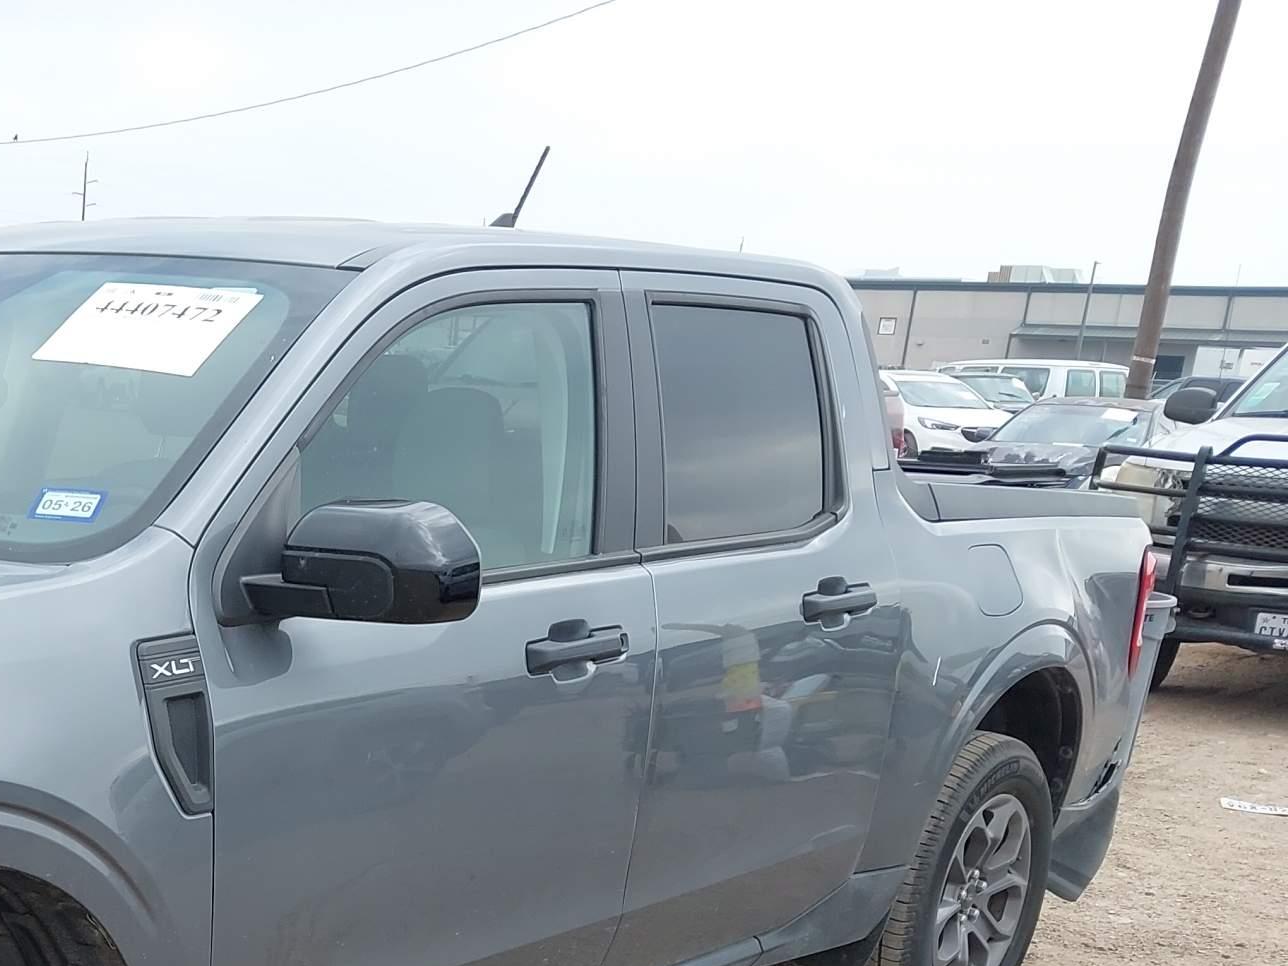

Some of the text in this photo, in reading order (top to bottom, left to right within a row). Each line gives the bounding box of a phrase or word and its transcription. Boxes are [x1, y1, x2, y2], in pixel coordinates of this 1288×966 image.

[95, 299, 224, 323] 44407472
[42, 499, 94, 513] 05 26
[150, 656, 201, 679] XLT
